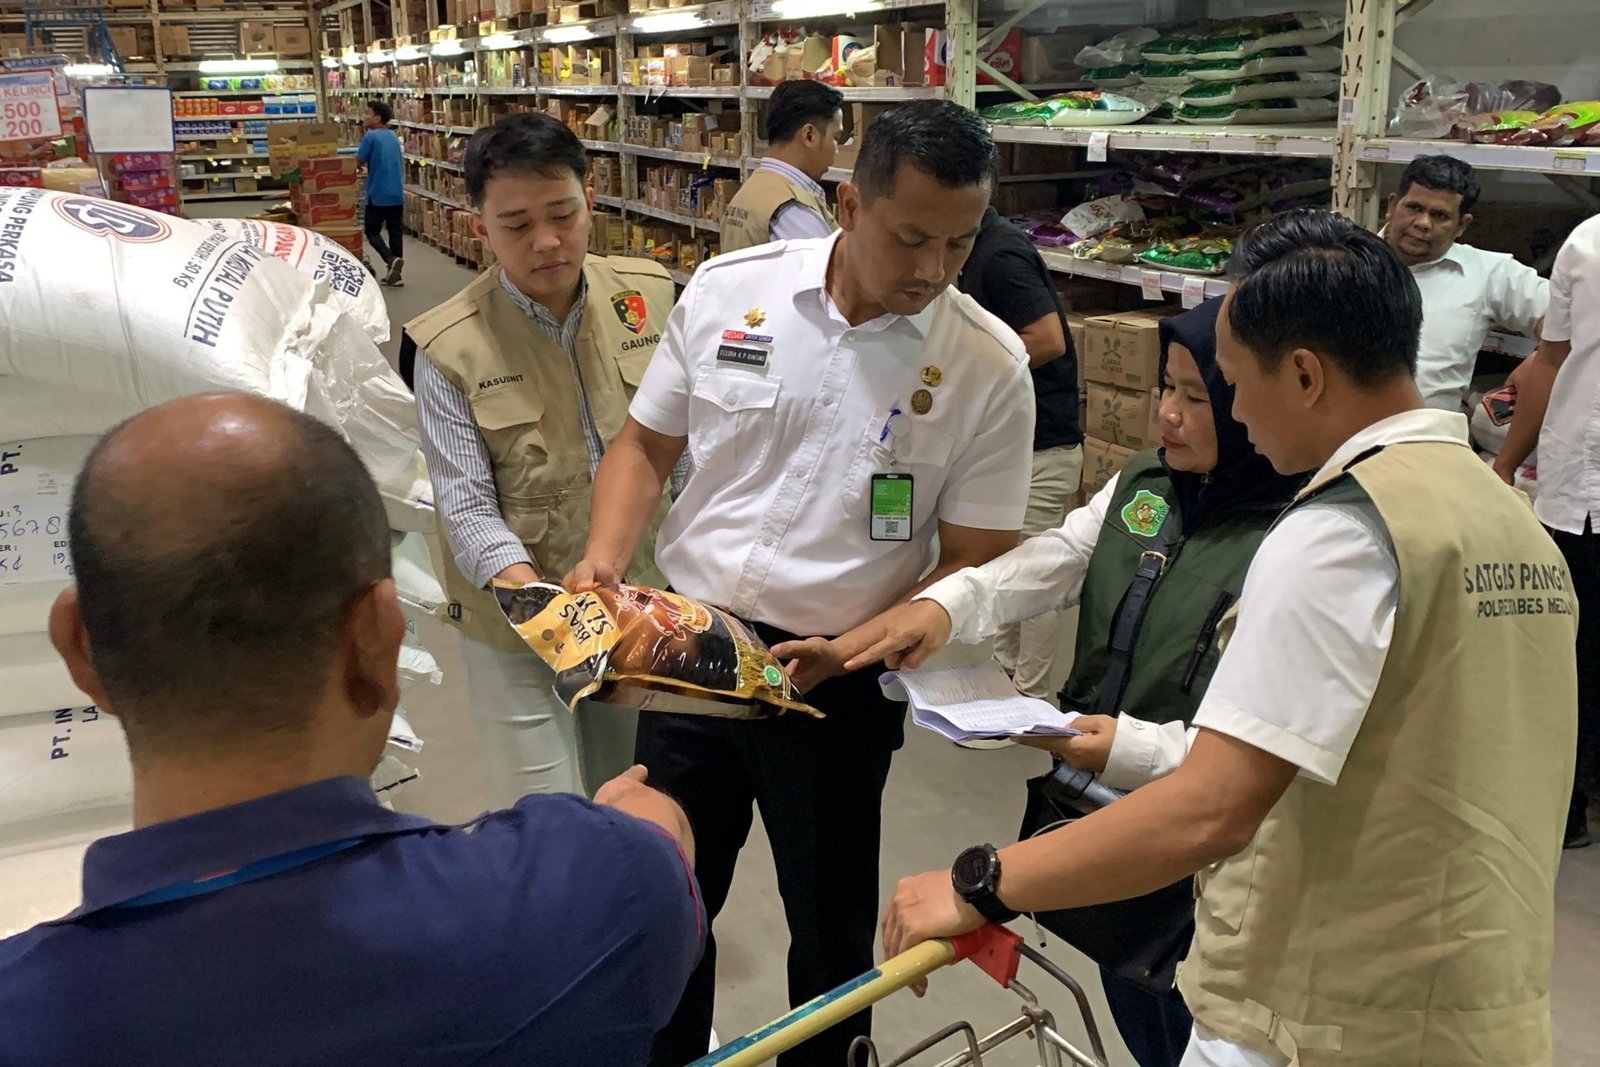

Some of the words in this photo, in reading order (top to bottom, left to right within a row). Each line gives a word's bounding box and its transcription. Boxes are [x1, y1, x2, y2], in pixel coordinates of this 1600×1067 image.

[4, 86, 51, 97] KELINCI
[191, 286, 234, 347] PUTIH
[621, 334, 661, 351] GAUNG
[1, 445, 22, 475] PT.
[51, 729, 71, 760] PT.
